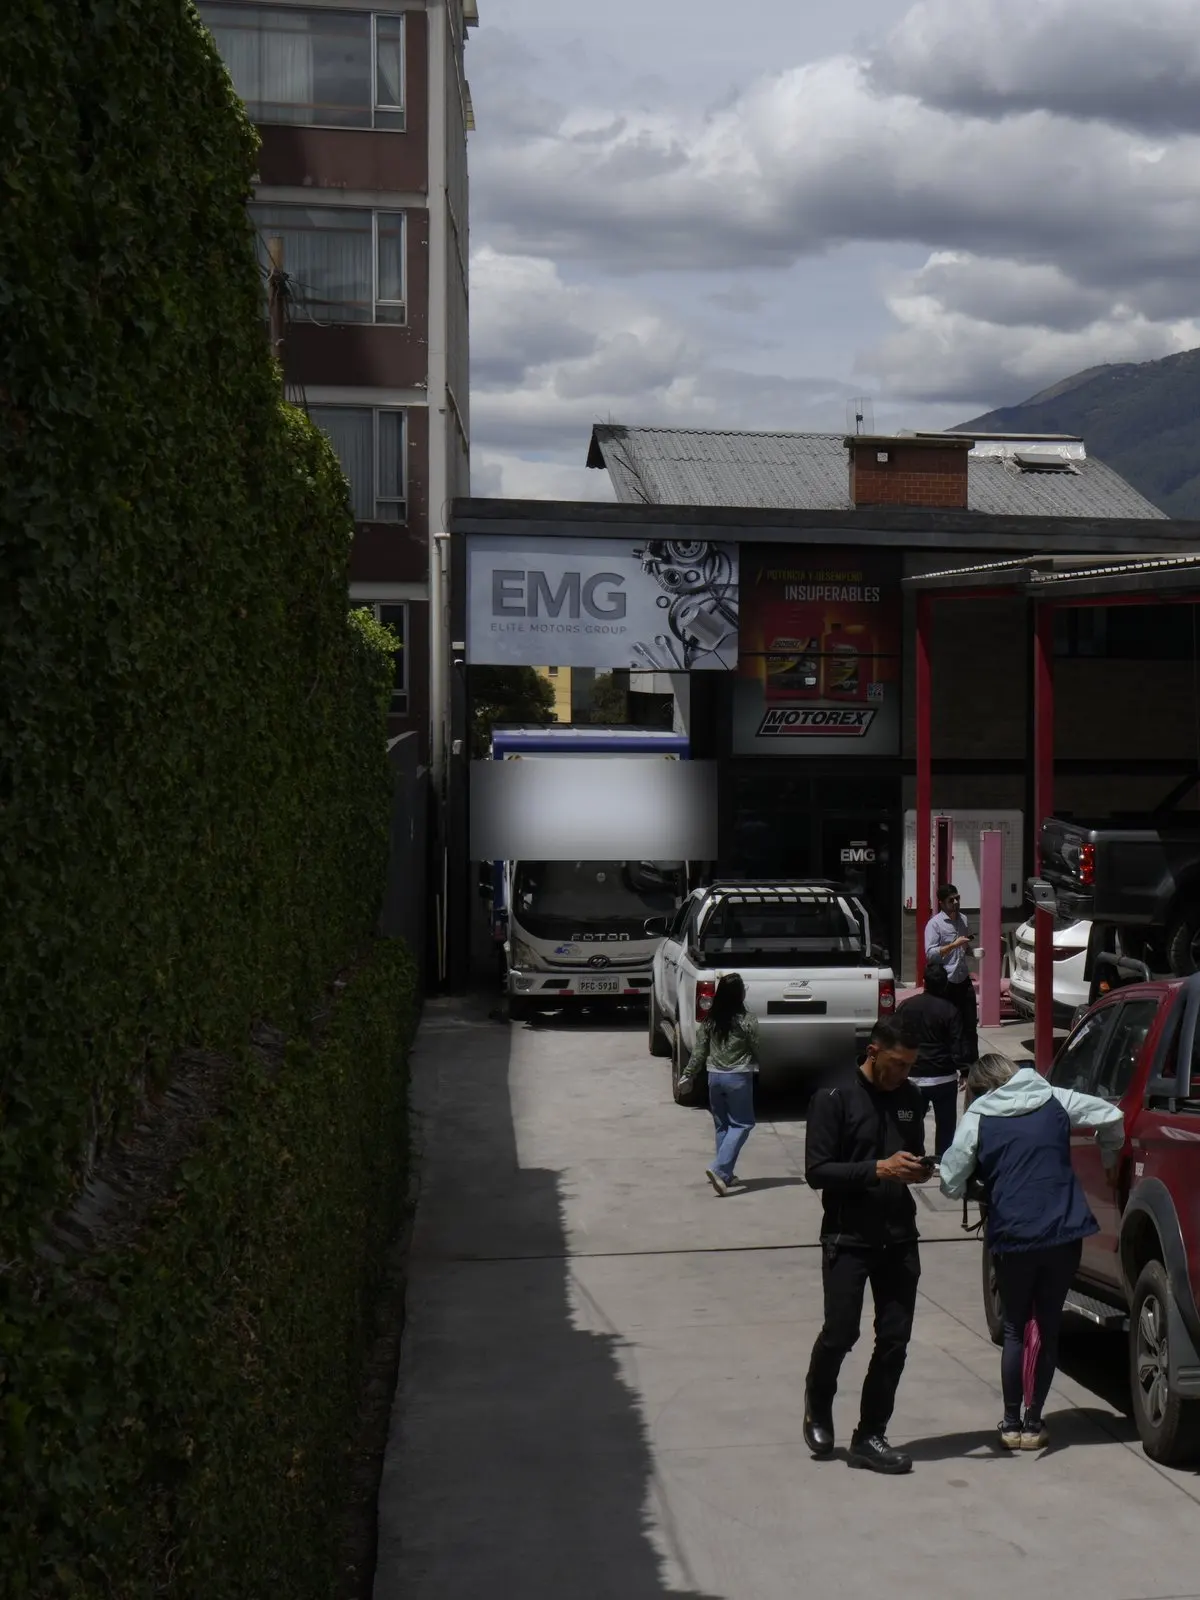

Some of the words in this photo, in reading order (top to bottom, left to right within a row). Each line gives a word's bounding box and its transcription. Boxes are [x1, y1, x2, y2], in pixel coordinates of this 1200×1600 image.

[492, 569, 627, 621] EMG
[785, 585, 881, 603] INSUPERABLES
[490, 622, 525, 632] ELITE
[529, 623, 581, 634] MOTORS
[584, 625, 628, 635] GROUP
[766, 711, 868, 725] MOTOREX
[840, 848, 876, 862] EMG
